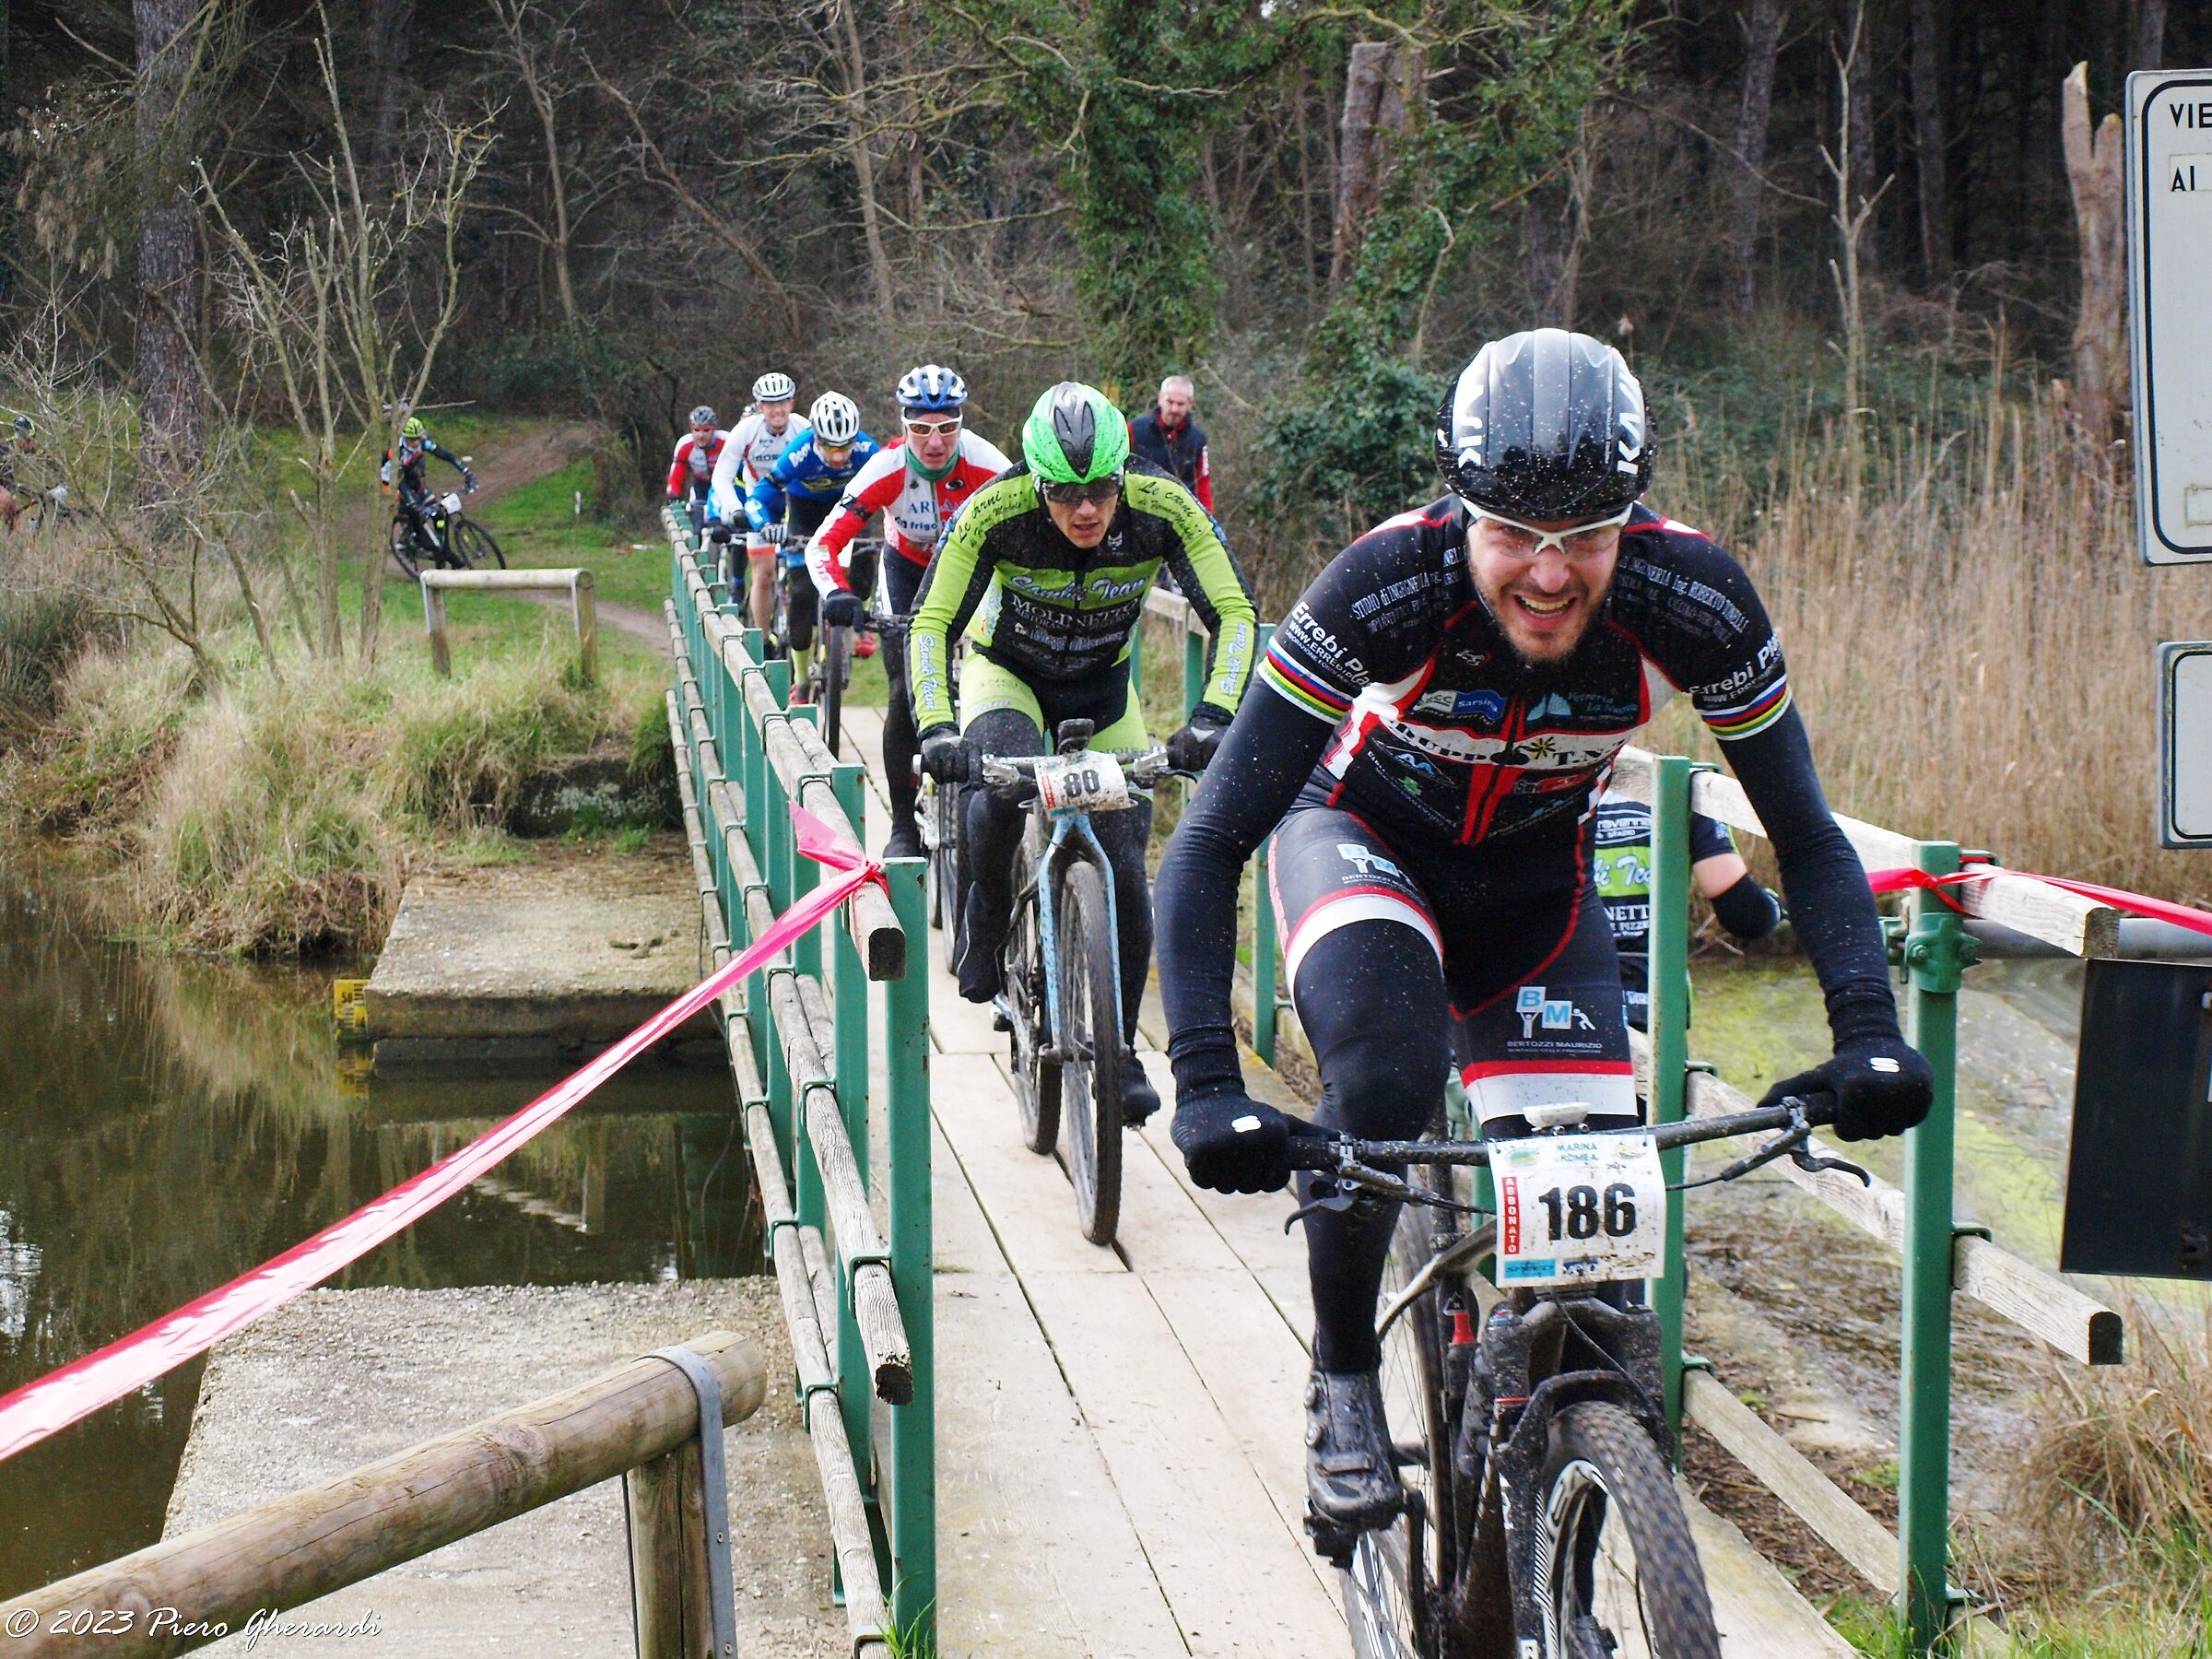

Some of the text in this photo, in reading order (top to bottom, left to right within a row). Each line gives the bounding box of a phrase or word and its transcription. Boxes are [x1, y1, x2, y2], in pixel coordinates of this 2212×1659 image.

[1387, 571, 1430, 603] INGEGNEIA
[1291, 600, 1348, 659] Errebi
[1344, 657, 1371, 688] Pla
[1064, 769, 1100, 798] 80
[1521, 990, 1570, 1024] B M
[1506, 1041, 1603, 1050] BERTOZZI MAURIZIO
[1505, 1177, 1518, 1253] ABBONATO
[1538, 1182, 1637, 1241] 186
